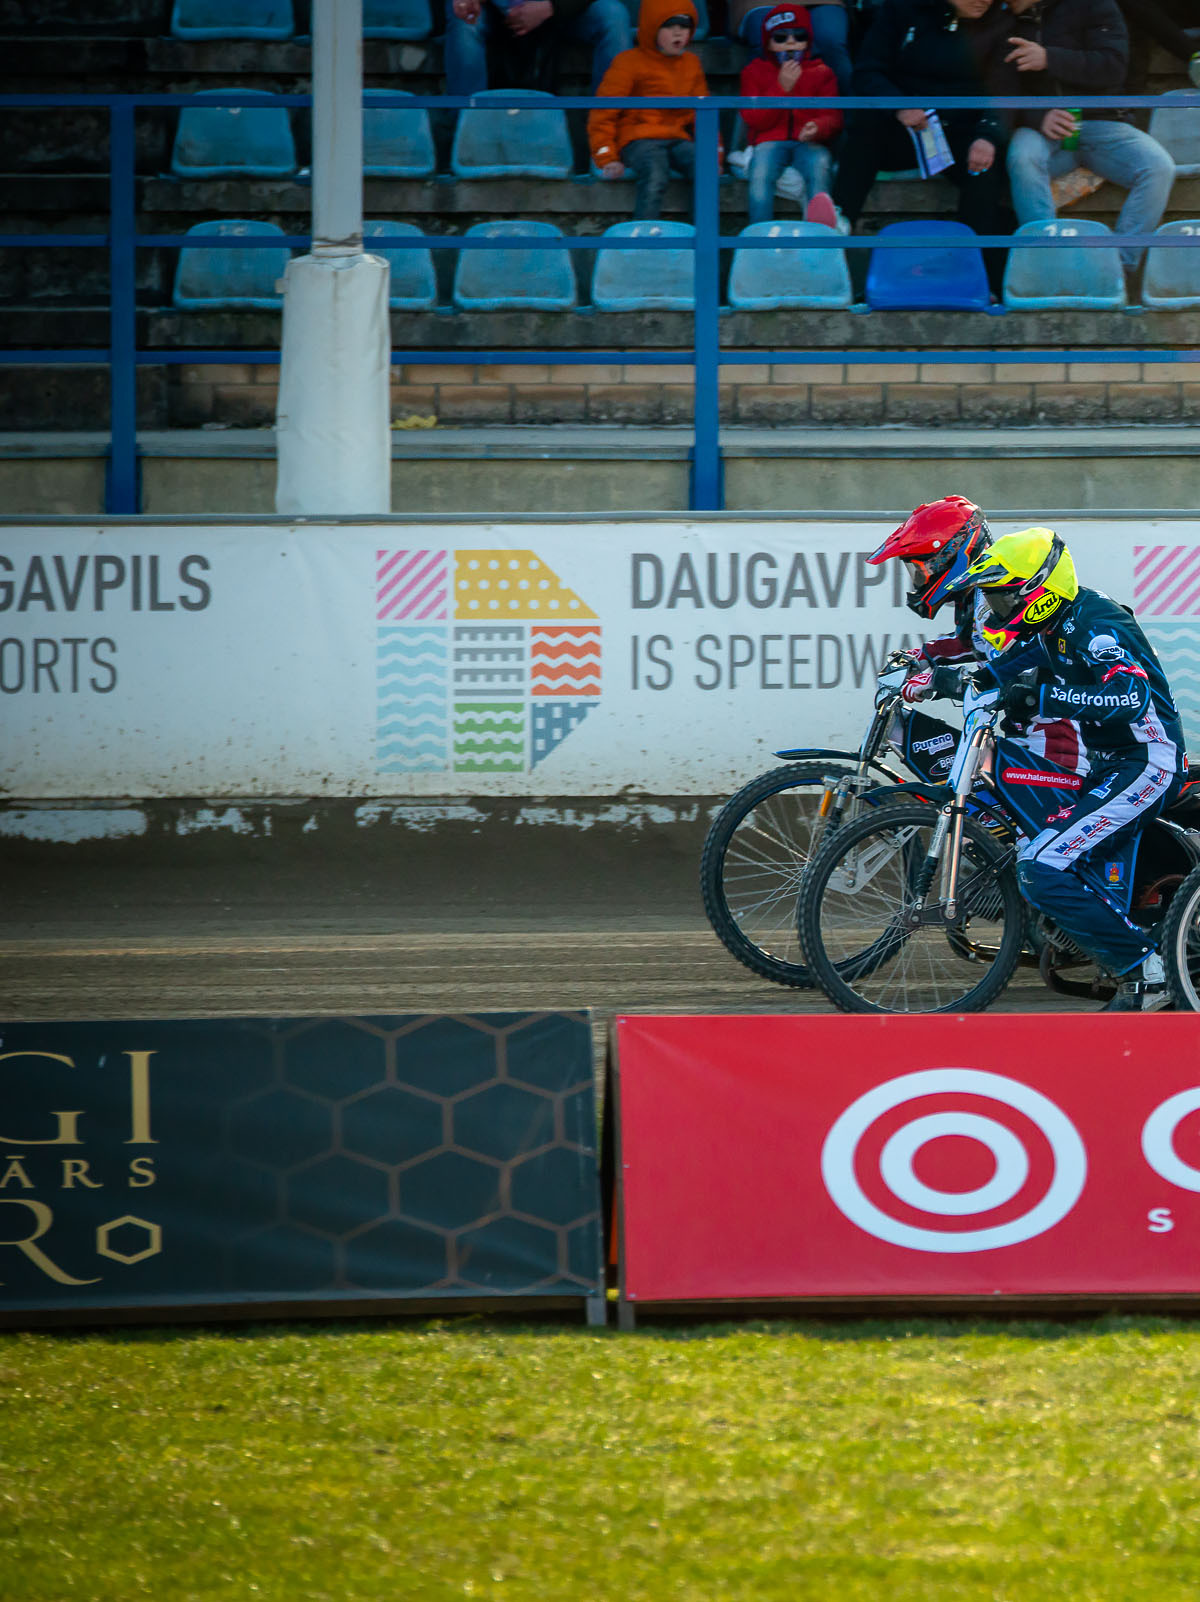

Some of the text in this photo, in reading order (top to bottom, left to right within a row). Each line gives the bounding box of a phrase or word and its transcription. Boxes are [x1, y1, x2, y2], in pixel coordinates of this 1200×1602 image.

[631, 552, 904, 609] DAUGAVPI
[1030, 593, 1057, 620] Arai
[0, 637, 117, 693] ORTS
[631, 634, 942, 691] IS SPEEDW
[1050, 686, 1142, 709] Saletromag
[913, 733, 952, 752] Pureno
[0, 1051, 160, 1145] GI
[0, 1155, 157, 1188] ĀRS
